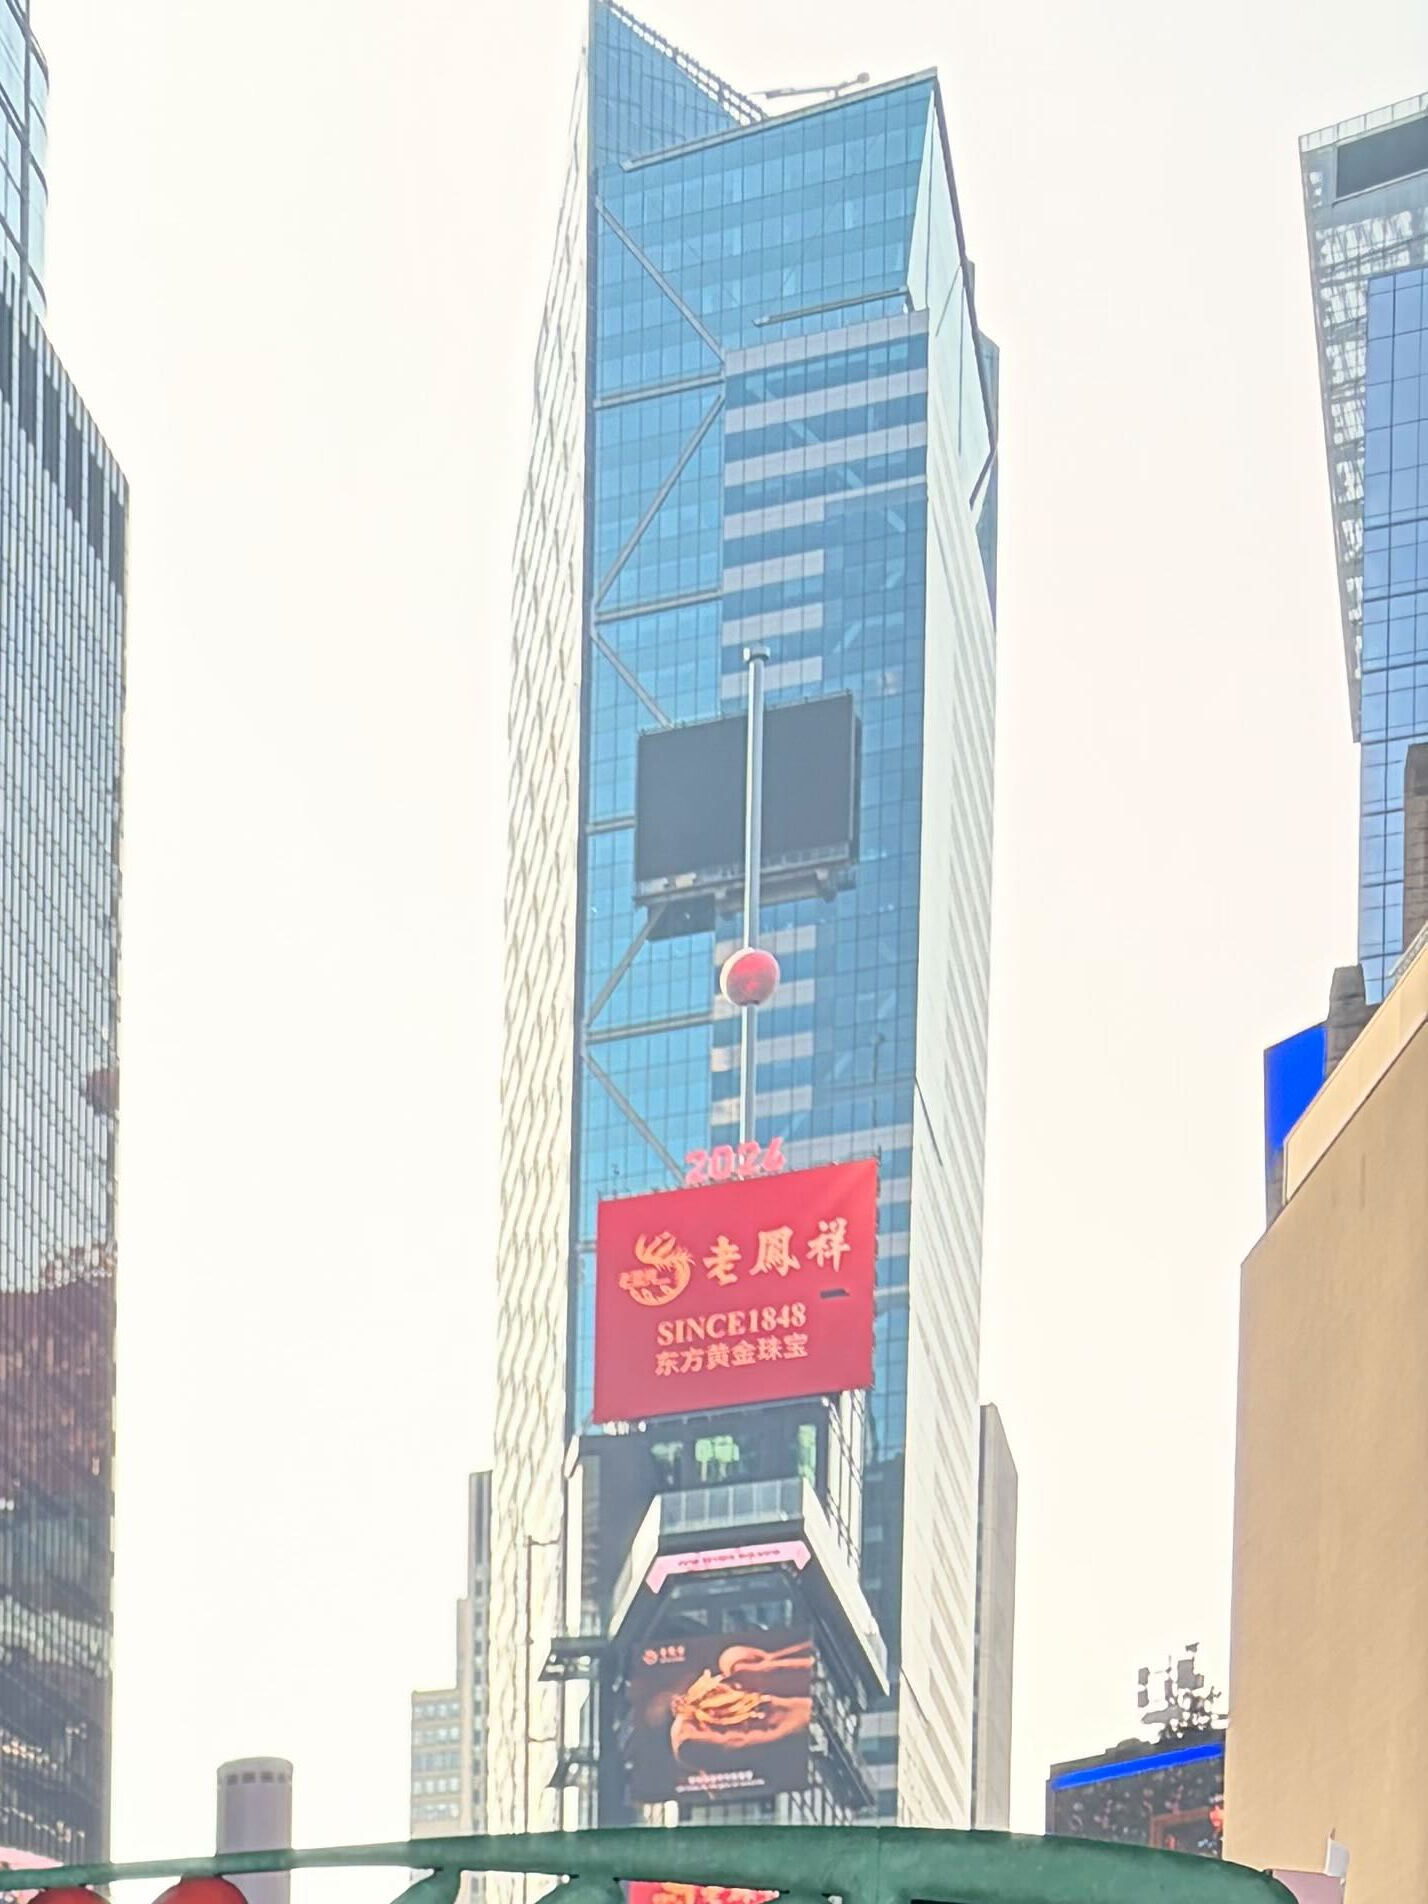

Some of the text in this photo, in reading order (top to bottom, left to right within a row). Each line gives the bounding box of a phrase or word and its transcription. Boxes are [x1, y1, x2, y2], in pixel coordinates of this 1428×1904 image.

[685, 1136, 787, 1187] 2026
[701, 1216, 852, 1287] 老鳳祥
[654, 1332, 809, 1377] 东方黄金珠宝
